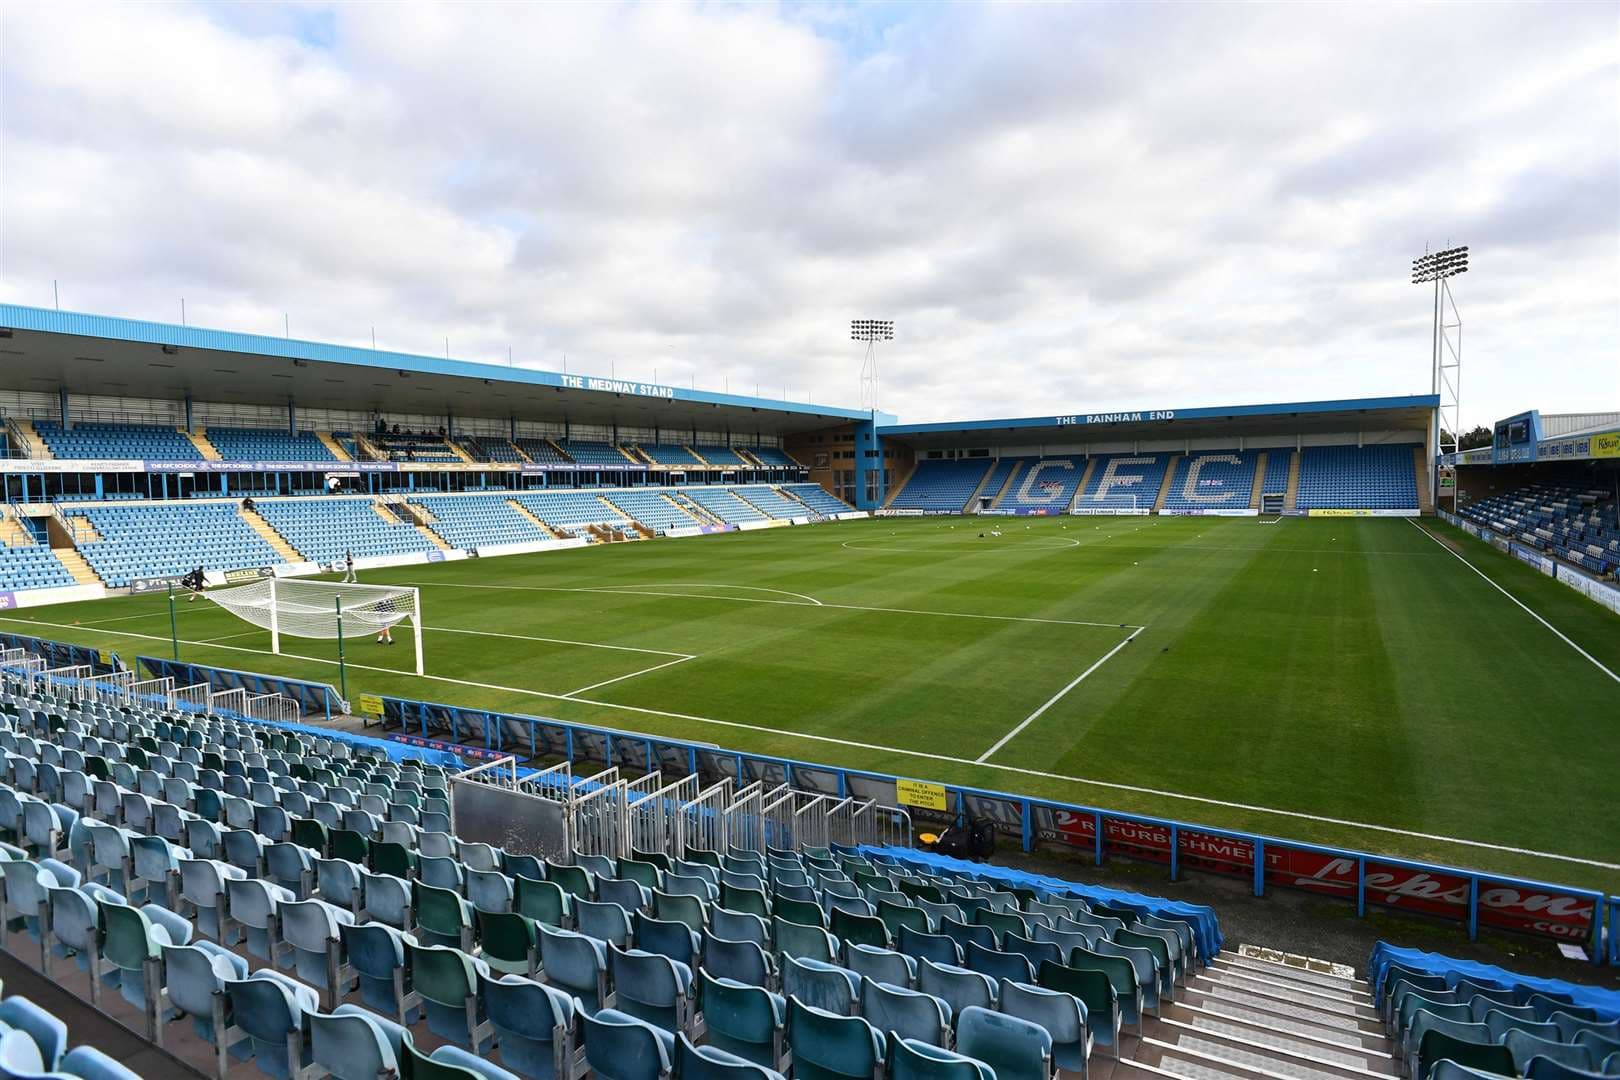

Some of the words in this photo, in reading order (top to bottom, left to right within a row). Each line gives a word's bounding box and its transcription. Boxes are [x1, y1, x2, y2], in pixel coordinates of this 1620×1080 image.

[561, 375, 584, 388] THE
[588, 377, 637, 394] MEDWAY
[640, 385, 674, 398] STAND
[1056, 416, 1077, 425] THE
[1086, 413, 1141, 424] RAINHAM
[1149, 411, 1175, 420] END
[1081, 820, 1282, 865] RFURBSHMET
